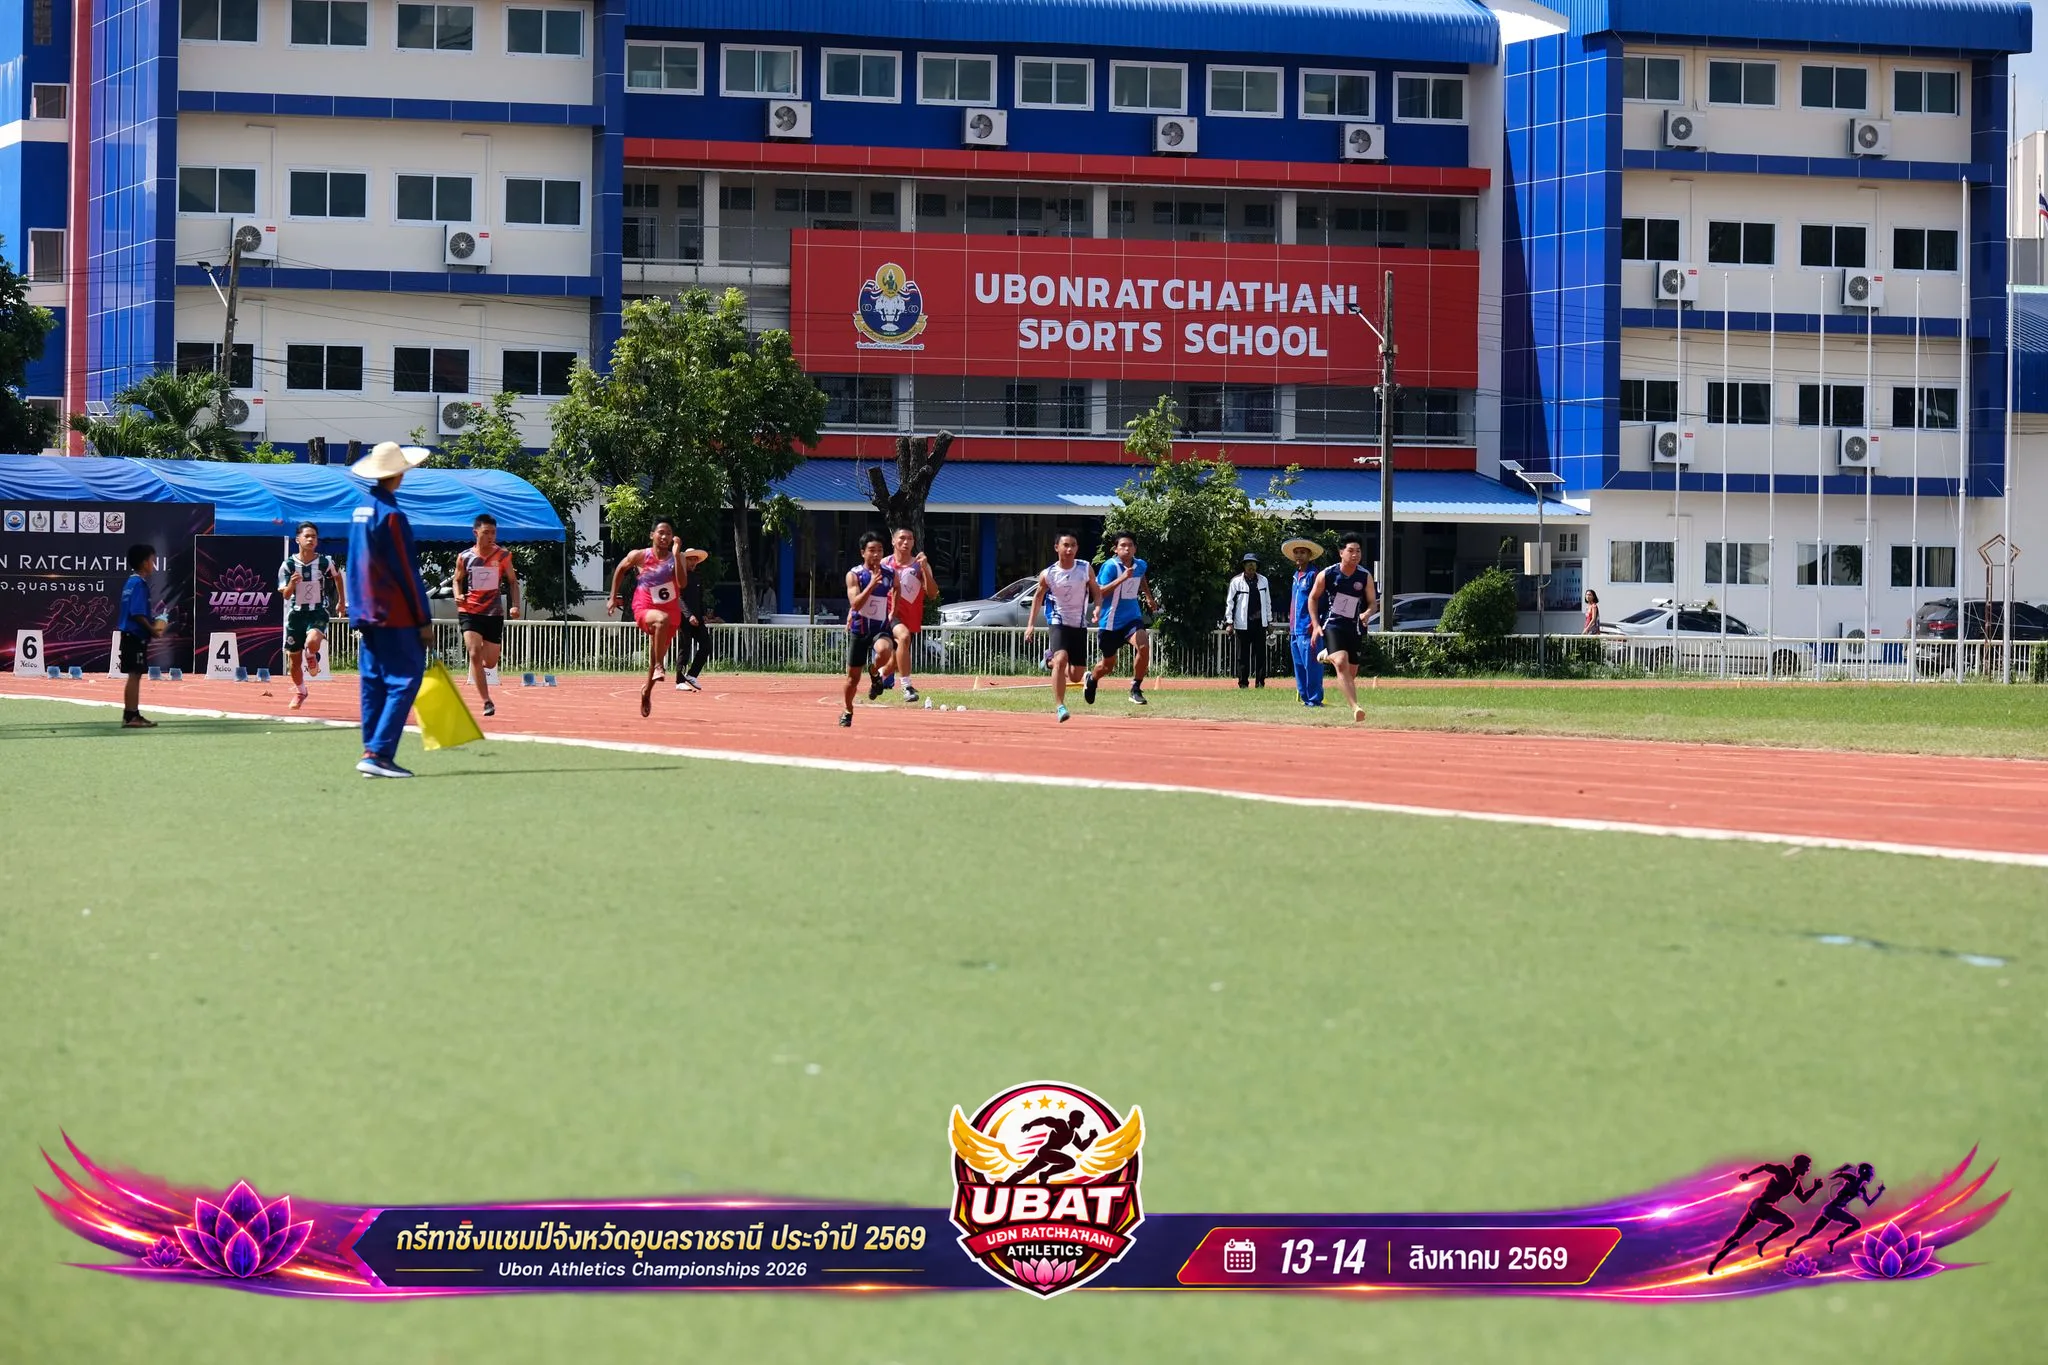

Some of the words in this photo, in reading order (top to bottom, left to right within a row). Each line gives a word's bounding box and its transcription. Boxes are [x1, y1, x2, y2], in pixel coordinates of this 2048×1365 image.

[975, 273, 1357, 315] UBONRATCHATHANI
[1019, 318, 1162, 352] SPORTS
[1184, 322, 1328, 357] SCHOOL
[19, 555, 167, 571] RATCHATHNI
[208, 591, 273, 606] UBON
[304, 583, 313, 601] 8
[658, 587, 670, 601] 6
[1063, 585, 1073, 603] 3
[210, 606, 269, 614] ATHLETICS
[867, 599, 880, 616] 5
[1340, 598, 1349, 613] 1
[22, 635, 38, 660] 6
[216, 640, 231, 664] 4
